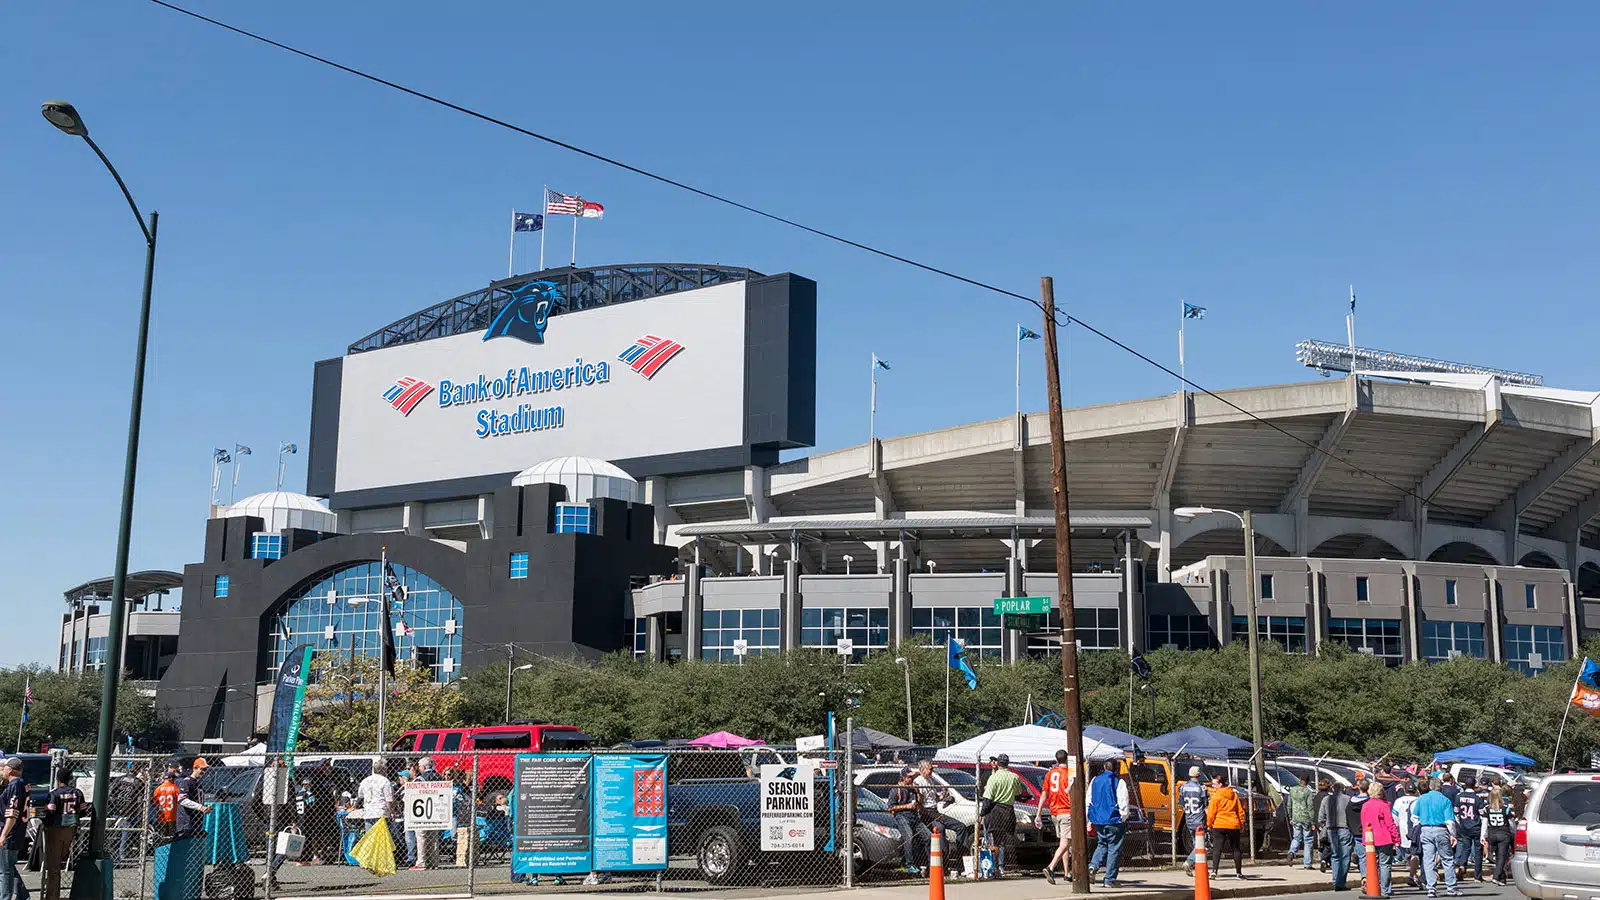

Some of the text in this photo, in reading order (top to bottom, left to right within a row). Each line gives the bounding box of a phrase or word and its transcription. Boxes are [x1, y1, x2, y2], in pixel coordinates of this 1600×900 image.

[439, 357, 610, 407] Bank of America
[475, 404, 564, 438] Stadium
[1002, 600, 1030, 611] POPLAR
[287, 700, 301, 744] TAILGATING
[768, 782, 806, 796] SEASON
[1050, 771, 1060, 792] 9
[160, 795, 173, 811] 23
[412, 797, 433, 820] 60
[766, 797, 809, 810] PARKING
[1460, 805, 1474, 820] 34
